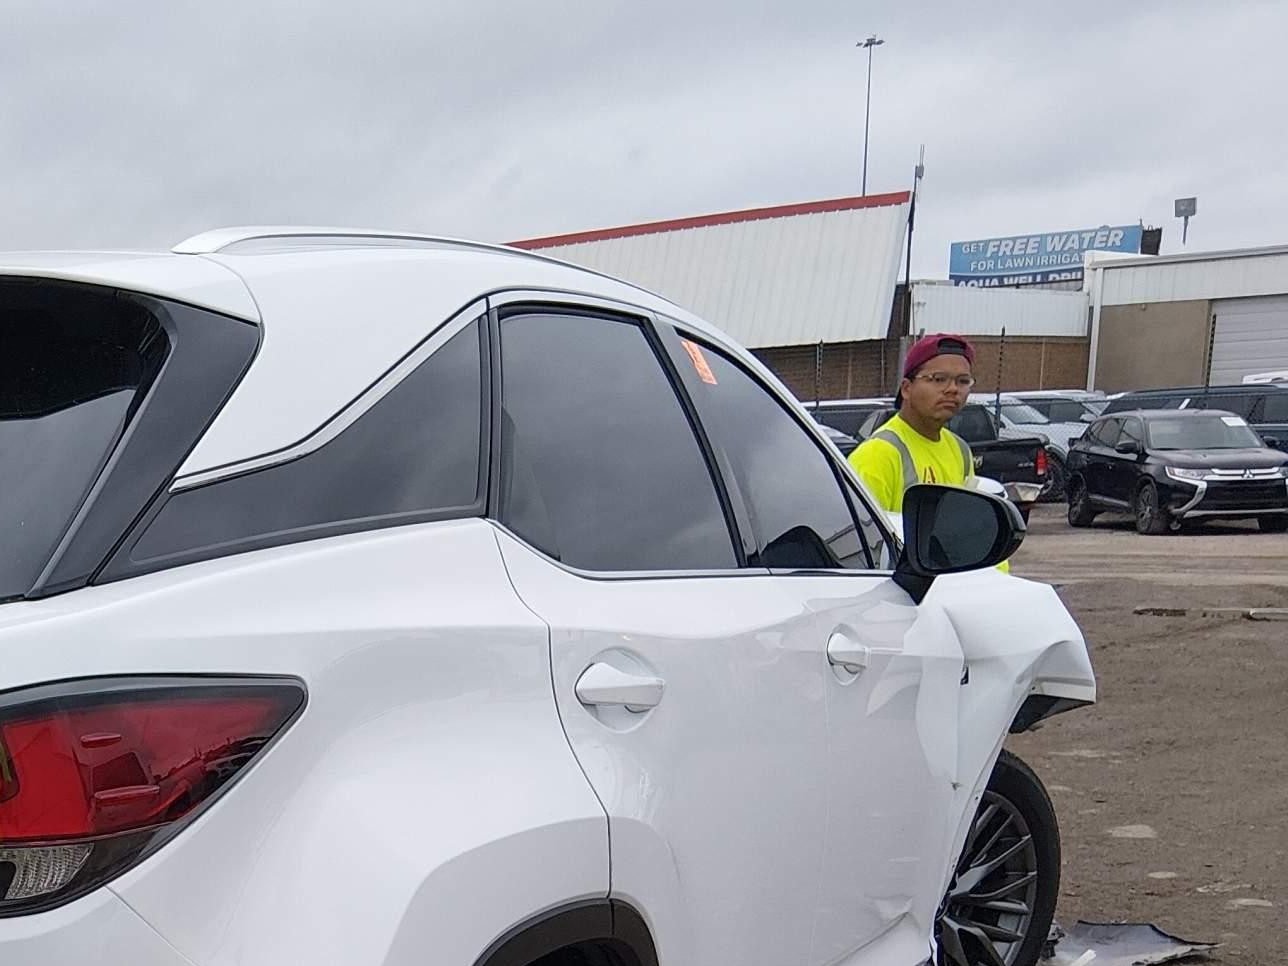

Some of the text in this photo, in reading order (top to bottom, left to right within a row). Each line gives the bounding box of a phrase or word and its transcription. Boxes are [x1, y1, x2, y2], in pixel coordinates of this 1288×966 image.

[962, 229, 1124, 258] GET FREE WATER
[970, 260, 995, 272] FOR
[997, 256, 1034, 269] LAWN
